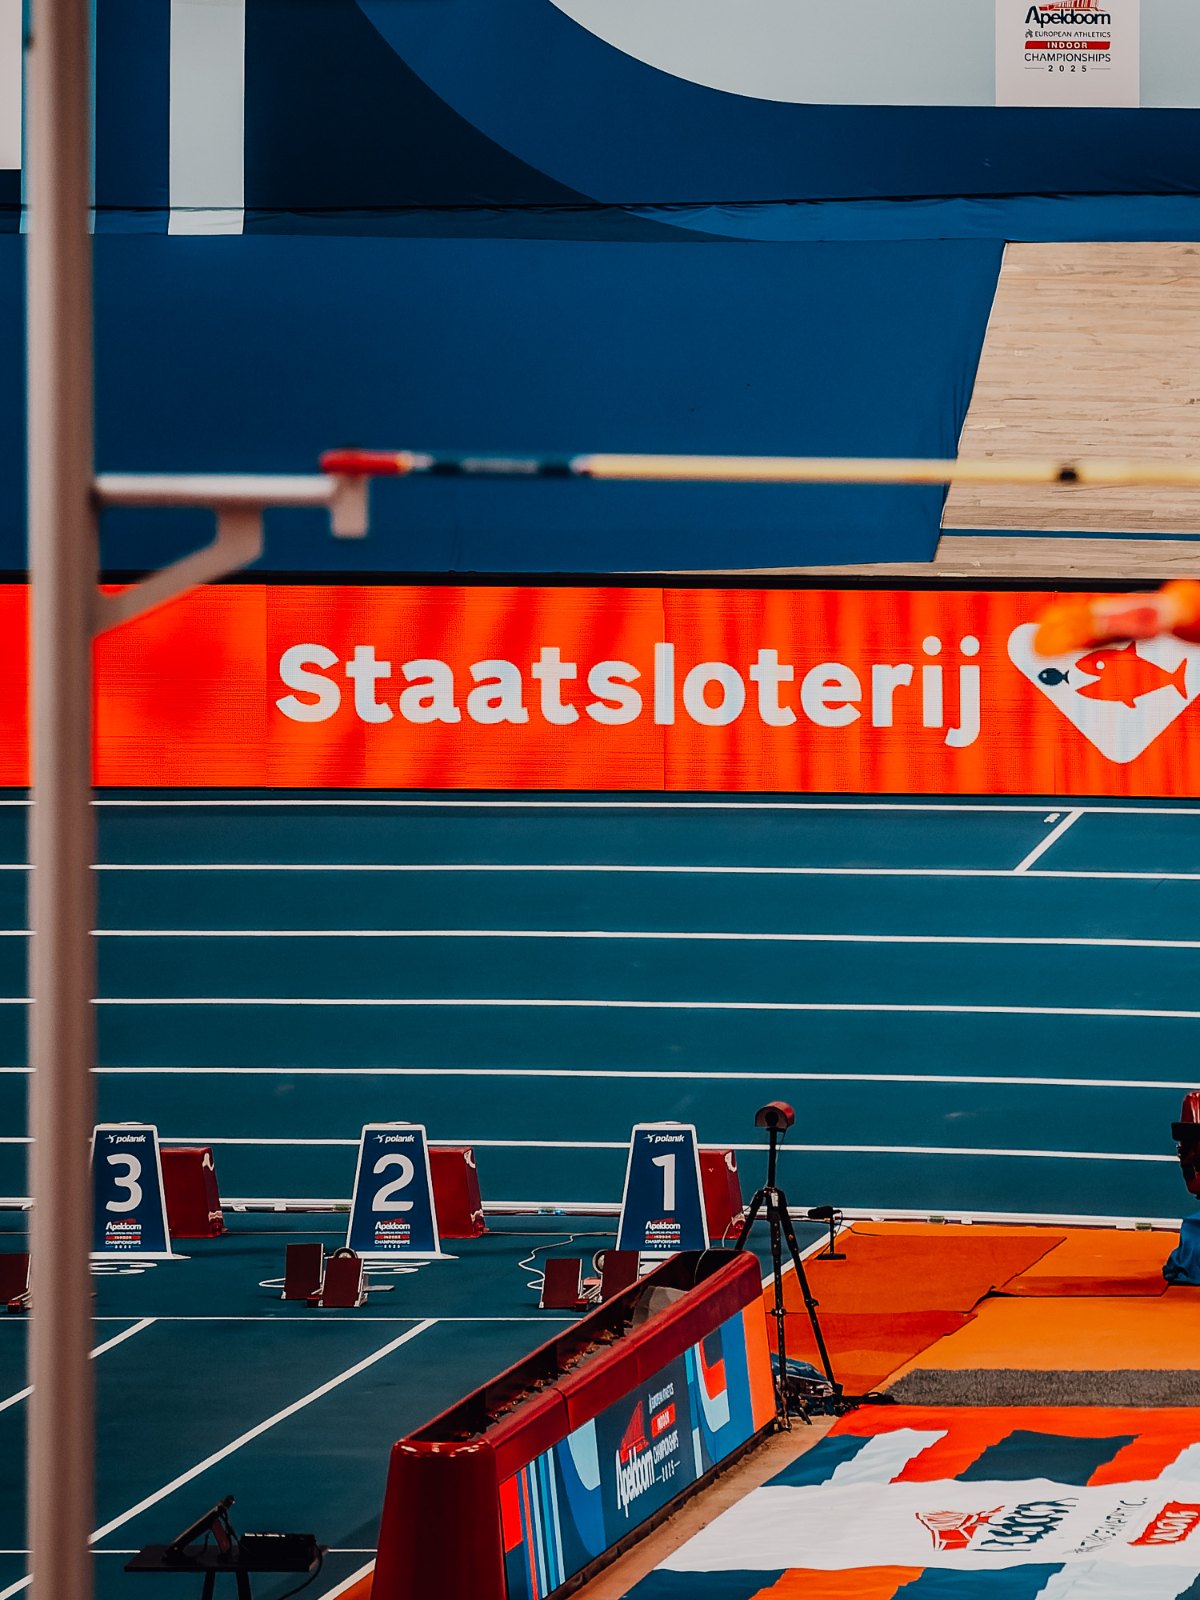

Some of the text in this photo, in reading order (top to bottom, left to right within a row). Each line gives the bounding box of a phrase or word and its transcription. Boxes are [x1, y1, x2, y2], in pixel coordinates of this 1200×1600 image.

[1047, 41, 1088, 49] INDOOR
[1024, 53, 1111, 62] CHAMPIONSHIPS
[275, 635, 981, 748] Staatsloterij
[116, 1134, 146, 1144] polanik
[385, 1134, 415, 1143] polanik
[655, 1134, 685, 1143] polanik
[105, 1153, 142, 1212] 3
[372, 1153, 414, 1212] 2
[651, 1153, 676, 1211] 1
